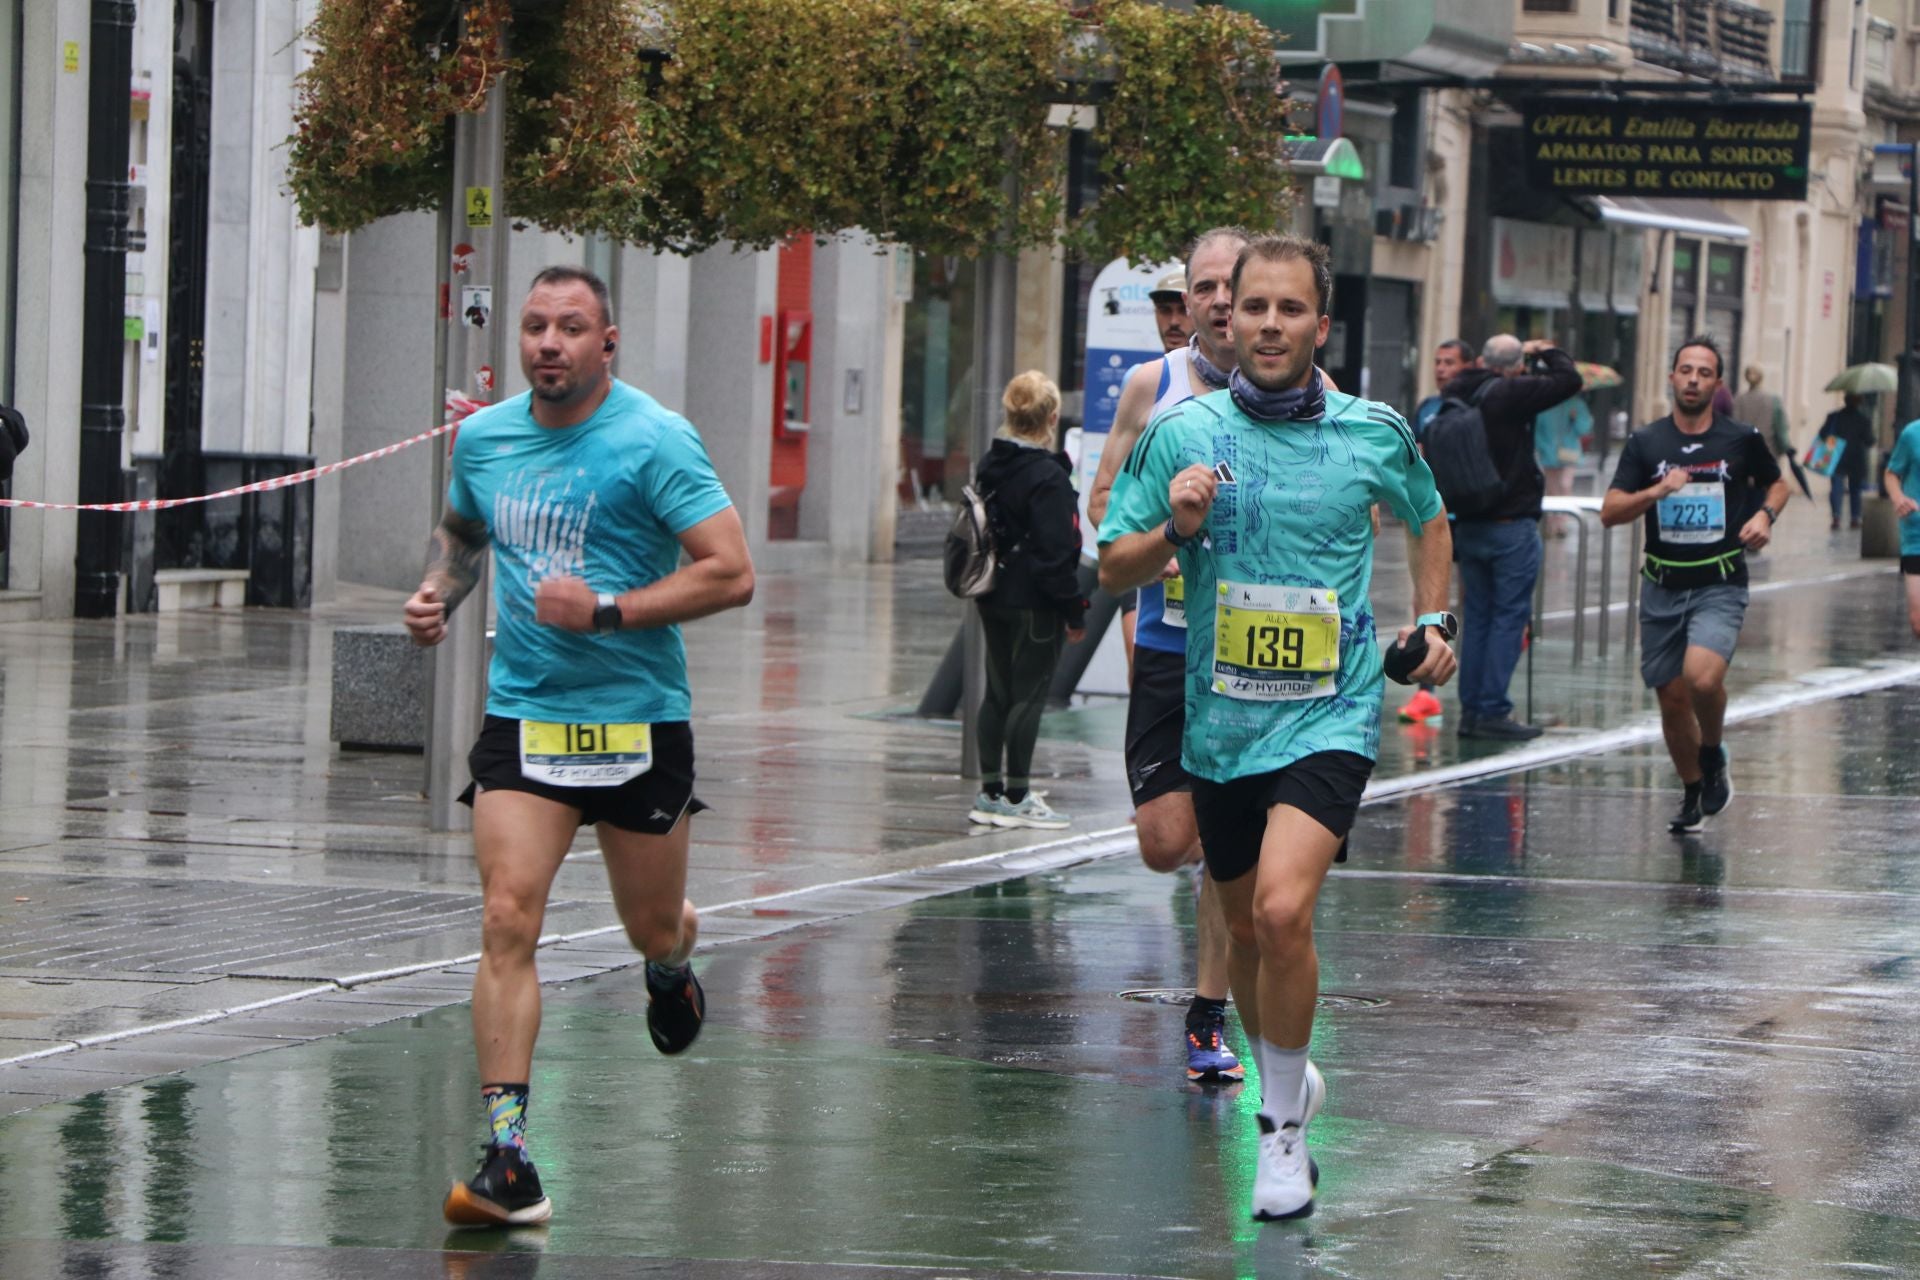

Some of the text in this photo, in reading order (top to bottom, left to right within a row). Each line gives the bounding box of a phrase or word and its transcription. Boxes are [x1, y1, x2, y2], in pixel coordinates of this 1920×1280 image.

[1532, 115, 1800, 141] OPTICA Emilia Barriada
[1537, 143, 1794, 166] APARATOS PARA SORDOS
[1553, 168, 1775, 190] LENTES DE CONTACTO
[1673, 504, 1709, 526] 223
[1246, 625, 1304, 668] 139
[566, 723, 607, 753] 161
